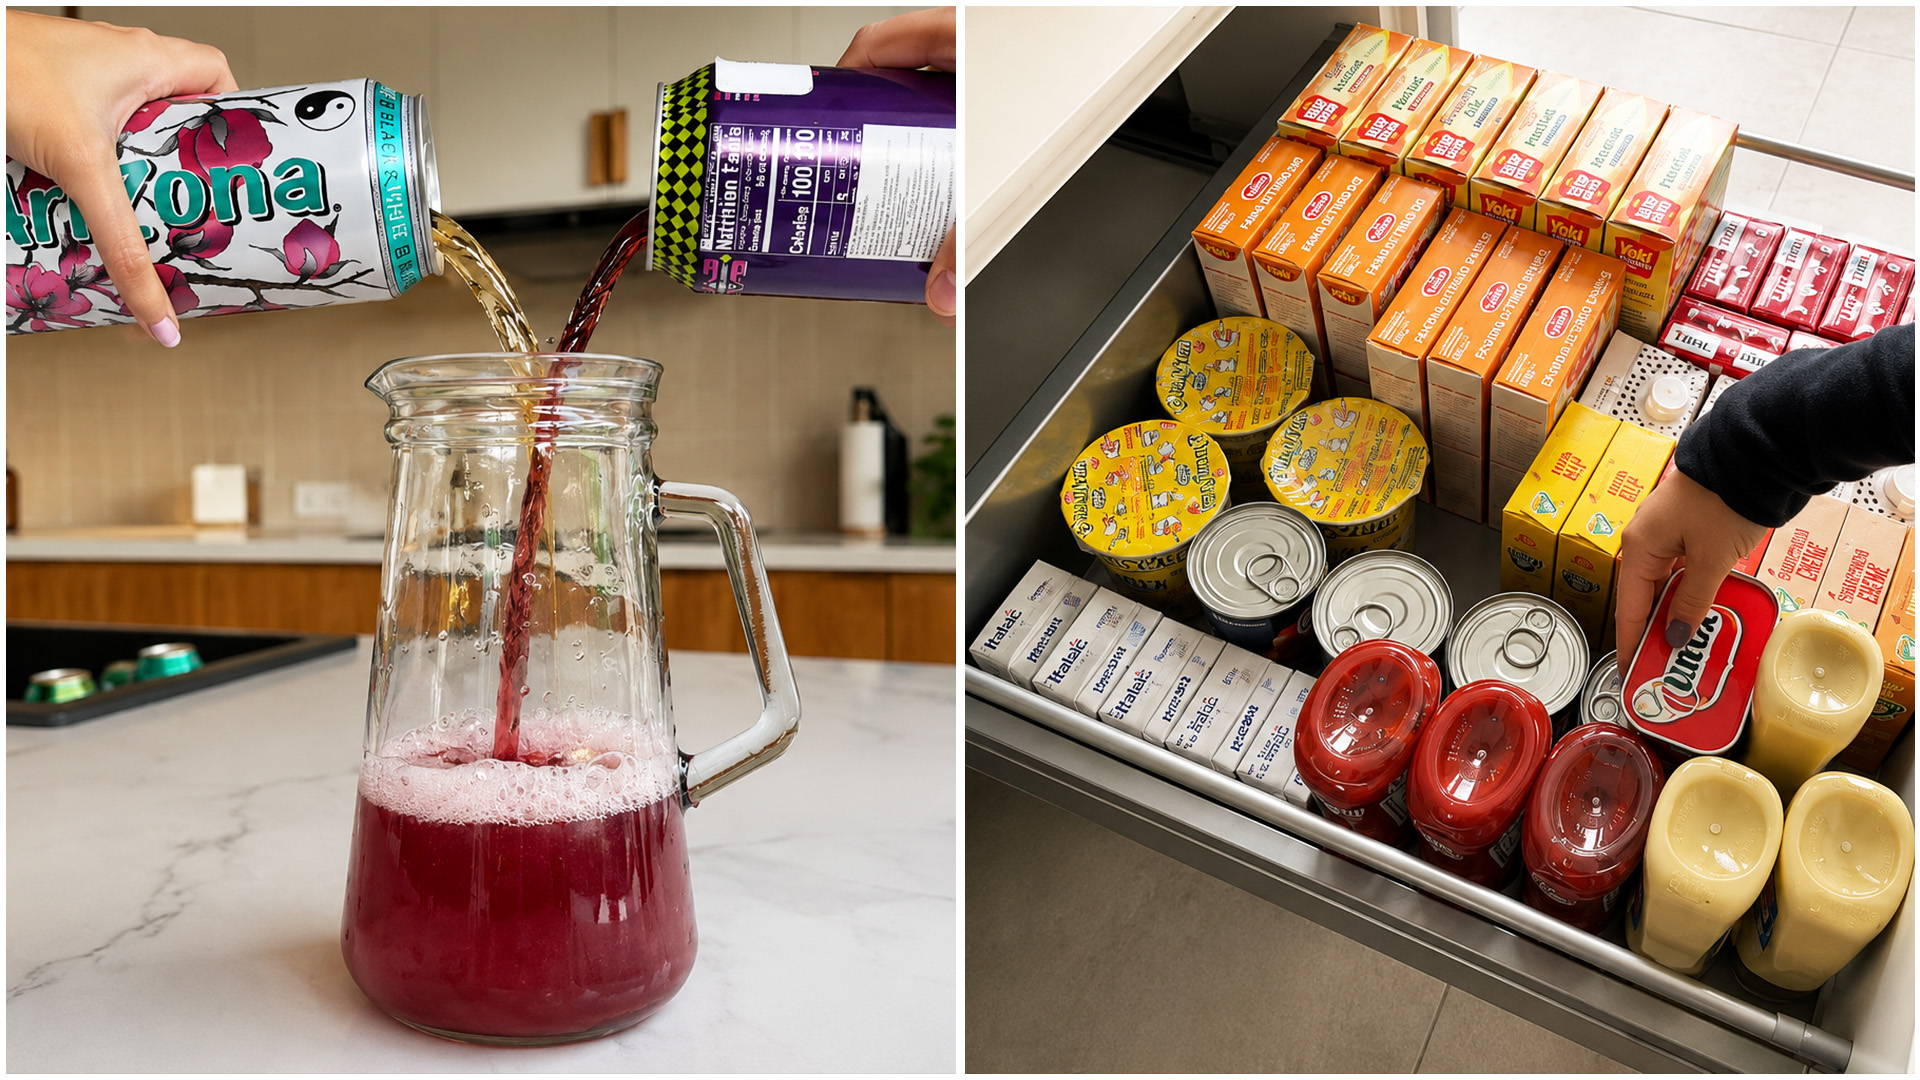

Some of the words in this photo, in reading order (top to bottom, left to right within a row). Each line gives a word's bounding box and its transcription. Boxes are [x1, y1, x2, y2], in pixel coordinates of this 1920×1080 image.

[791, 166, 813, 199] 100
[1485, 197, 1517, 219] Yoki
[1550, 219, 1584, 241] Yoki
[1619, 240, 1653, 263] Yoki
